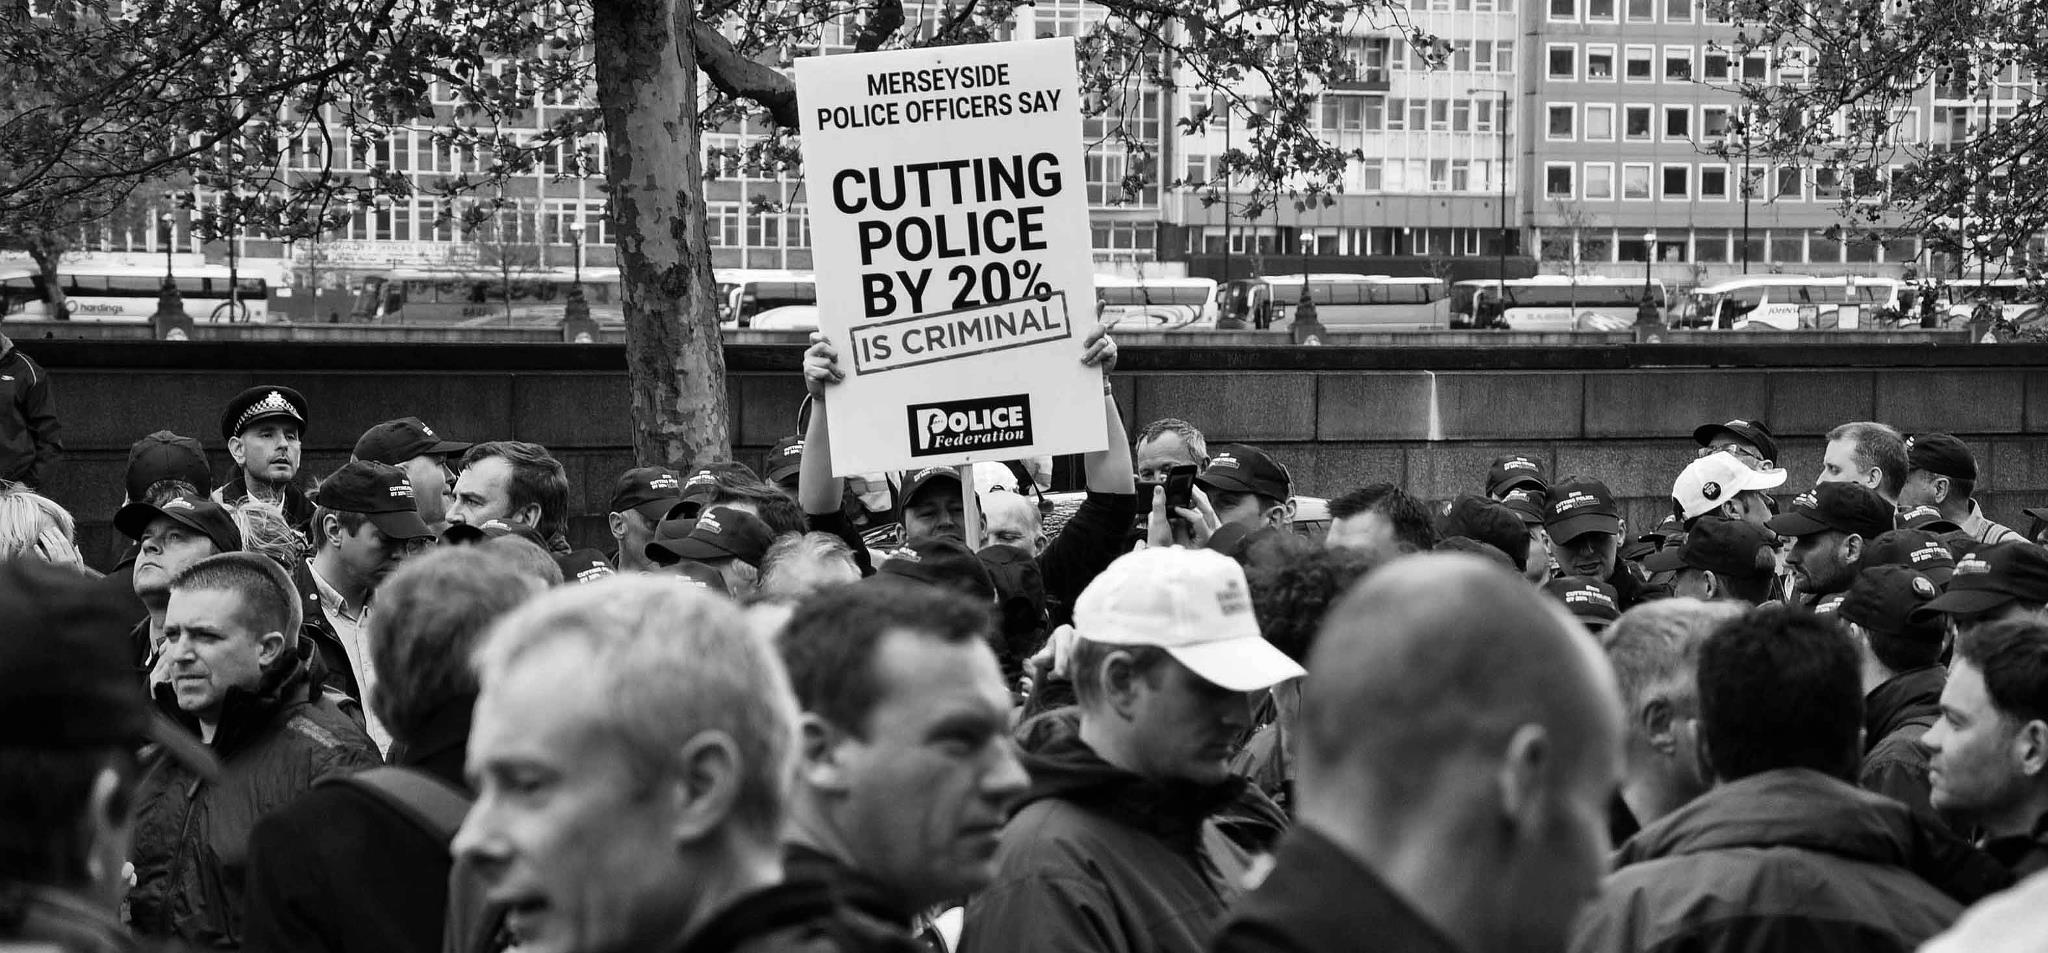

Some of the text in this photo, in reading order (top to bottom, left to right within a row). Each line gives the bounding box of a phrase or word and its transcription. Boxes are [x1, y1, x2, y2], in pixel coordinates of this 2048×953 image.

[867, 64, 1010, 97] MERSEYSIDE
[818, 89, 1062, 131] POLICE OFFICERS SAY
[832, 152, 1062, 215] CUTTING
[858, 206, 1048, 266] POLICE
[81, 303, 123, 315] hardings
[862, 259, 1053, 319] BY 20%
[861, 305, 1062, 364] IS CRIMINAL
[917, 405, 1024, 450] POLICE
[935, 430, 1025, 448] Federation
